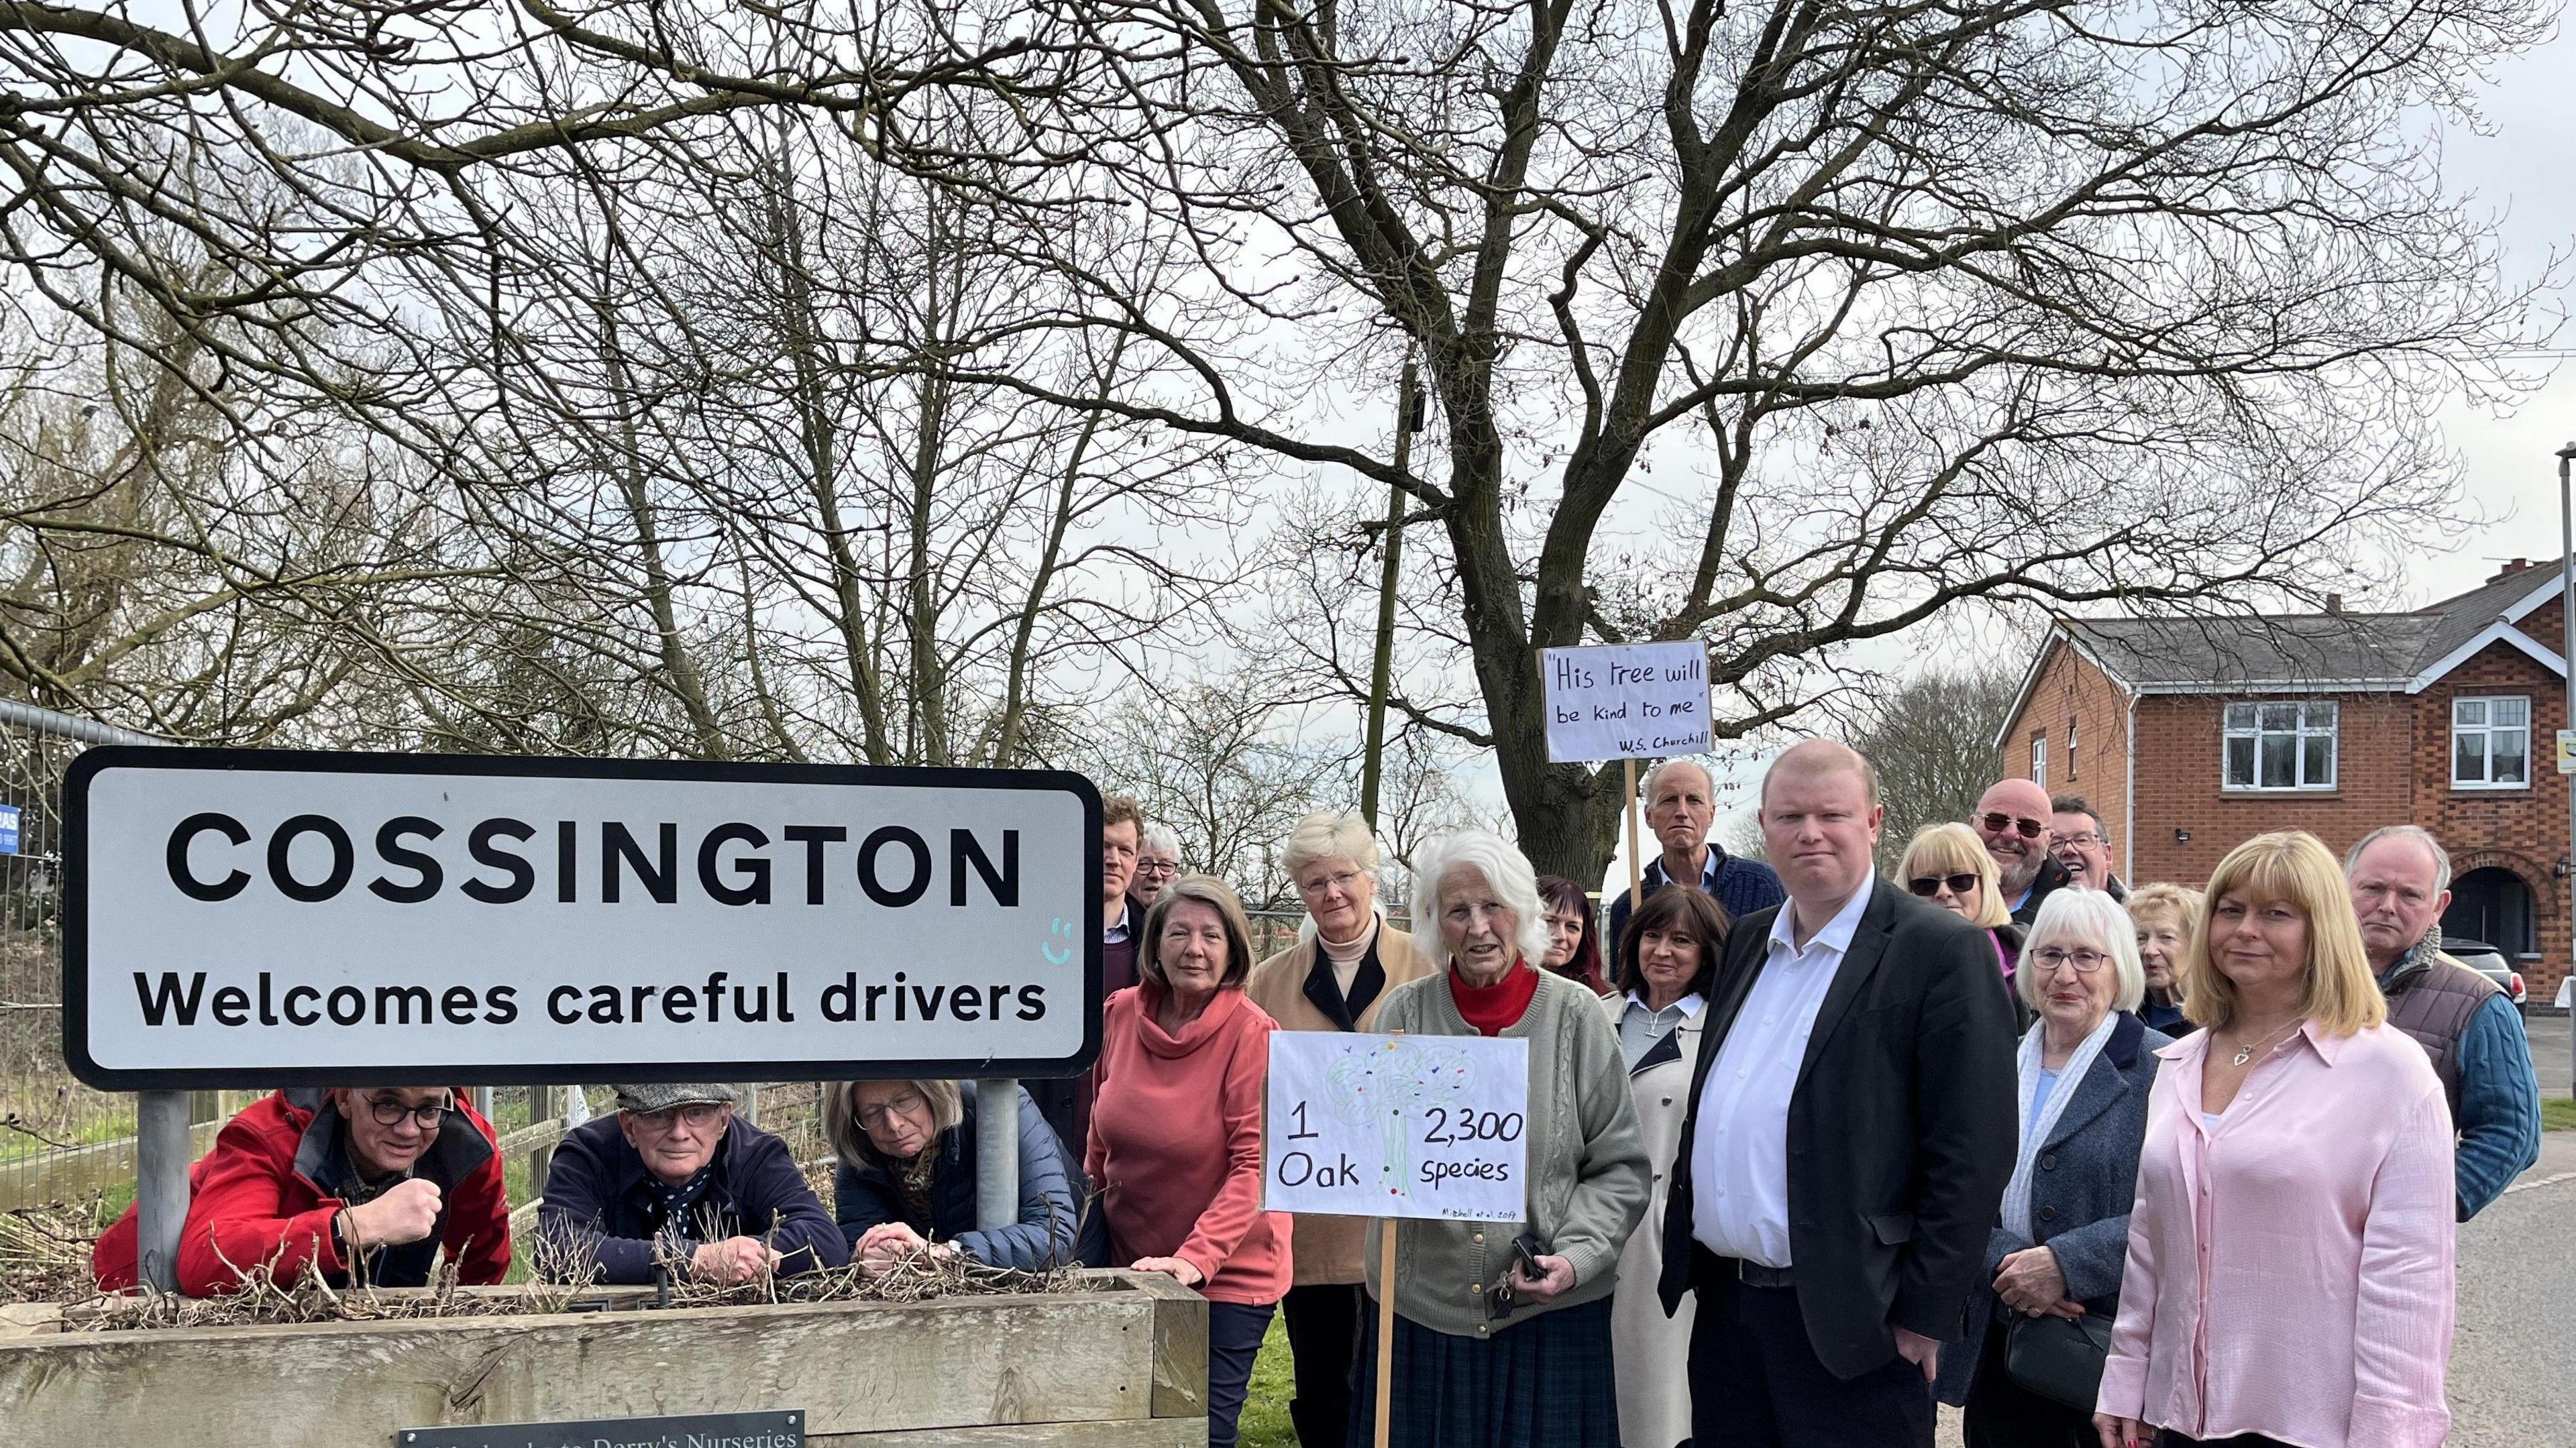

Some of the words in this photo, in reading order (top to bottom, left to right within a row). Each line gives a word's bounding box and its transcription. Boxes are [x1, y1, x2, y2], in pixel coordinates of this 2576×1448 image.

[1611, 661, 1654, 685] tree
[1666, 659, 1700, 683] will
[1556, 705, 1580, 723] be
[1594, 702, 1626, 721] kind
[1643, 702, 1661, 717] to
[1619, 738, 1647, 753] W.S.
[1653, 730, 1709, 749] Churchill
[166, 812, 1019, 908] COSSINGTON
[133, 972, 519, 1027] Welcomes
[547, 970, 796, 1025] careful
[820, 970, 1046, 1022] drivers
[1287, 1100, 1319, 1140] 1
[1424, 1107, 1524, 1148] 2,300
[1278, 1152, 1360, 1188] Oak
[1420, 1158, 1509, 1190] species
[686, 1429, 797, 1448] Nurseries
